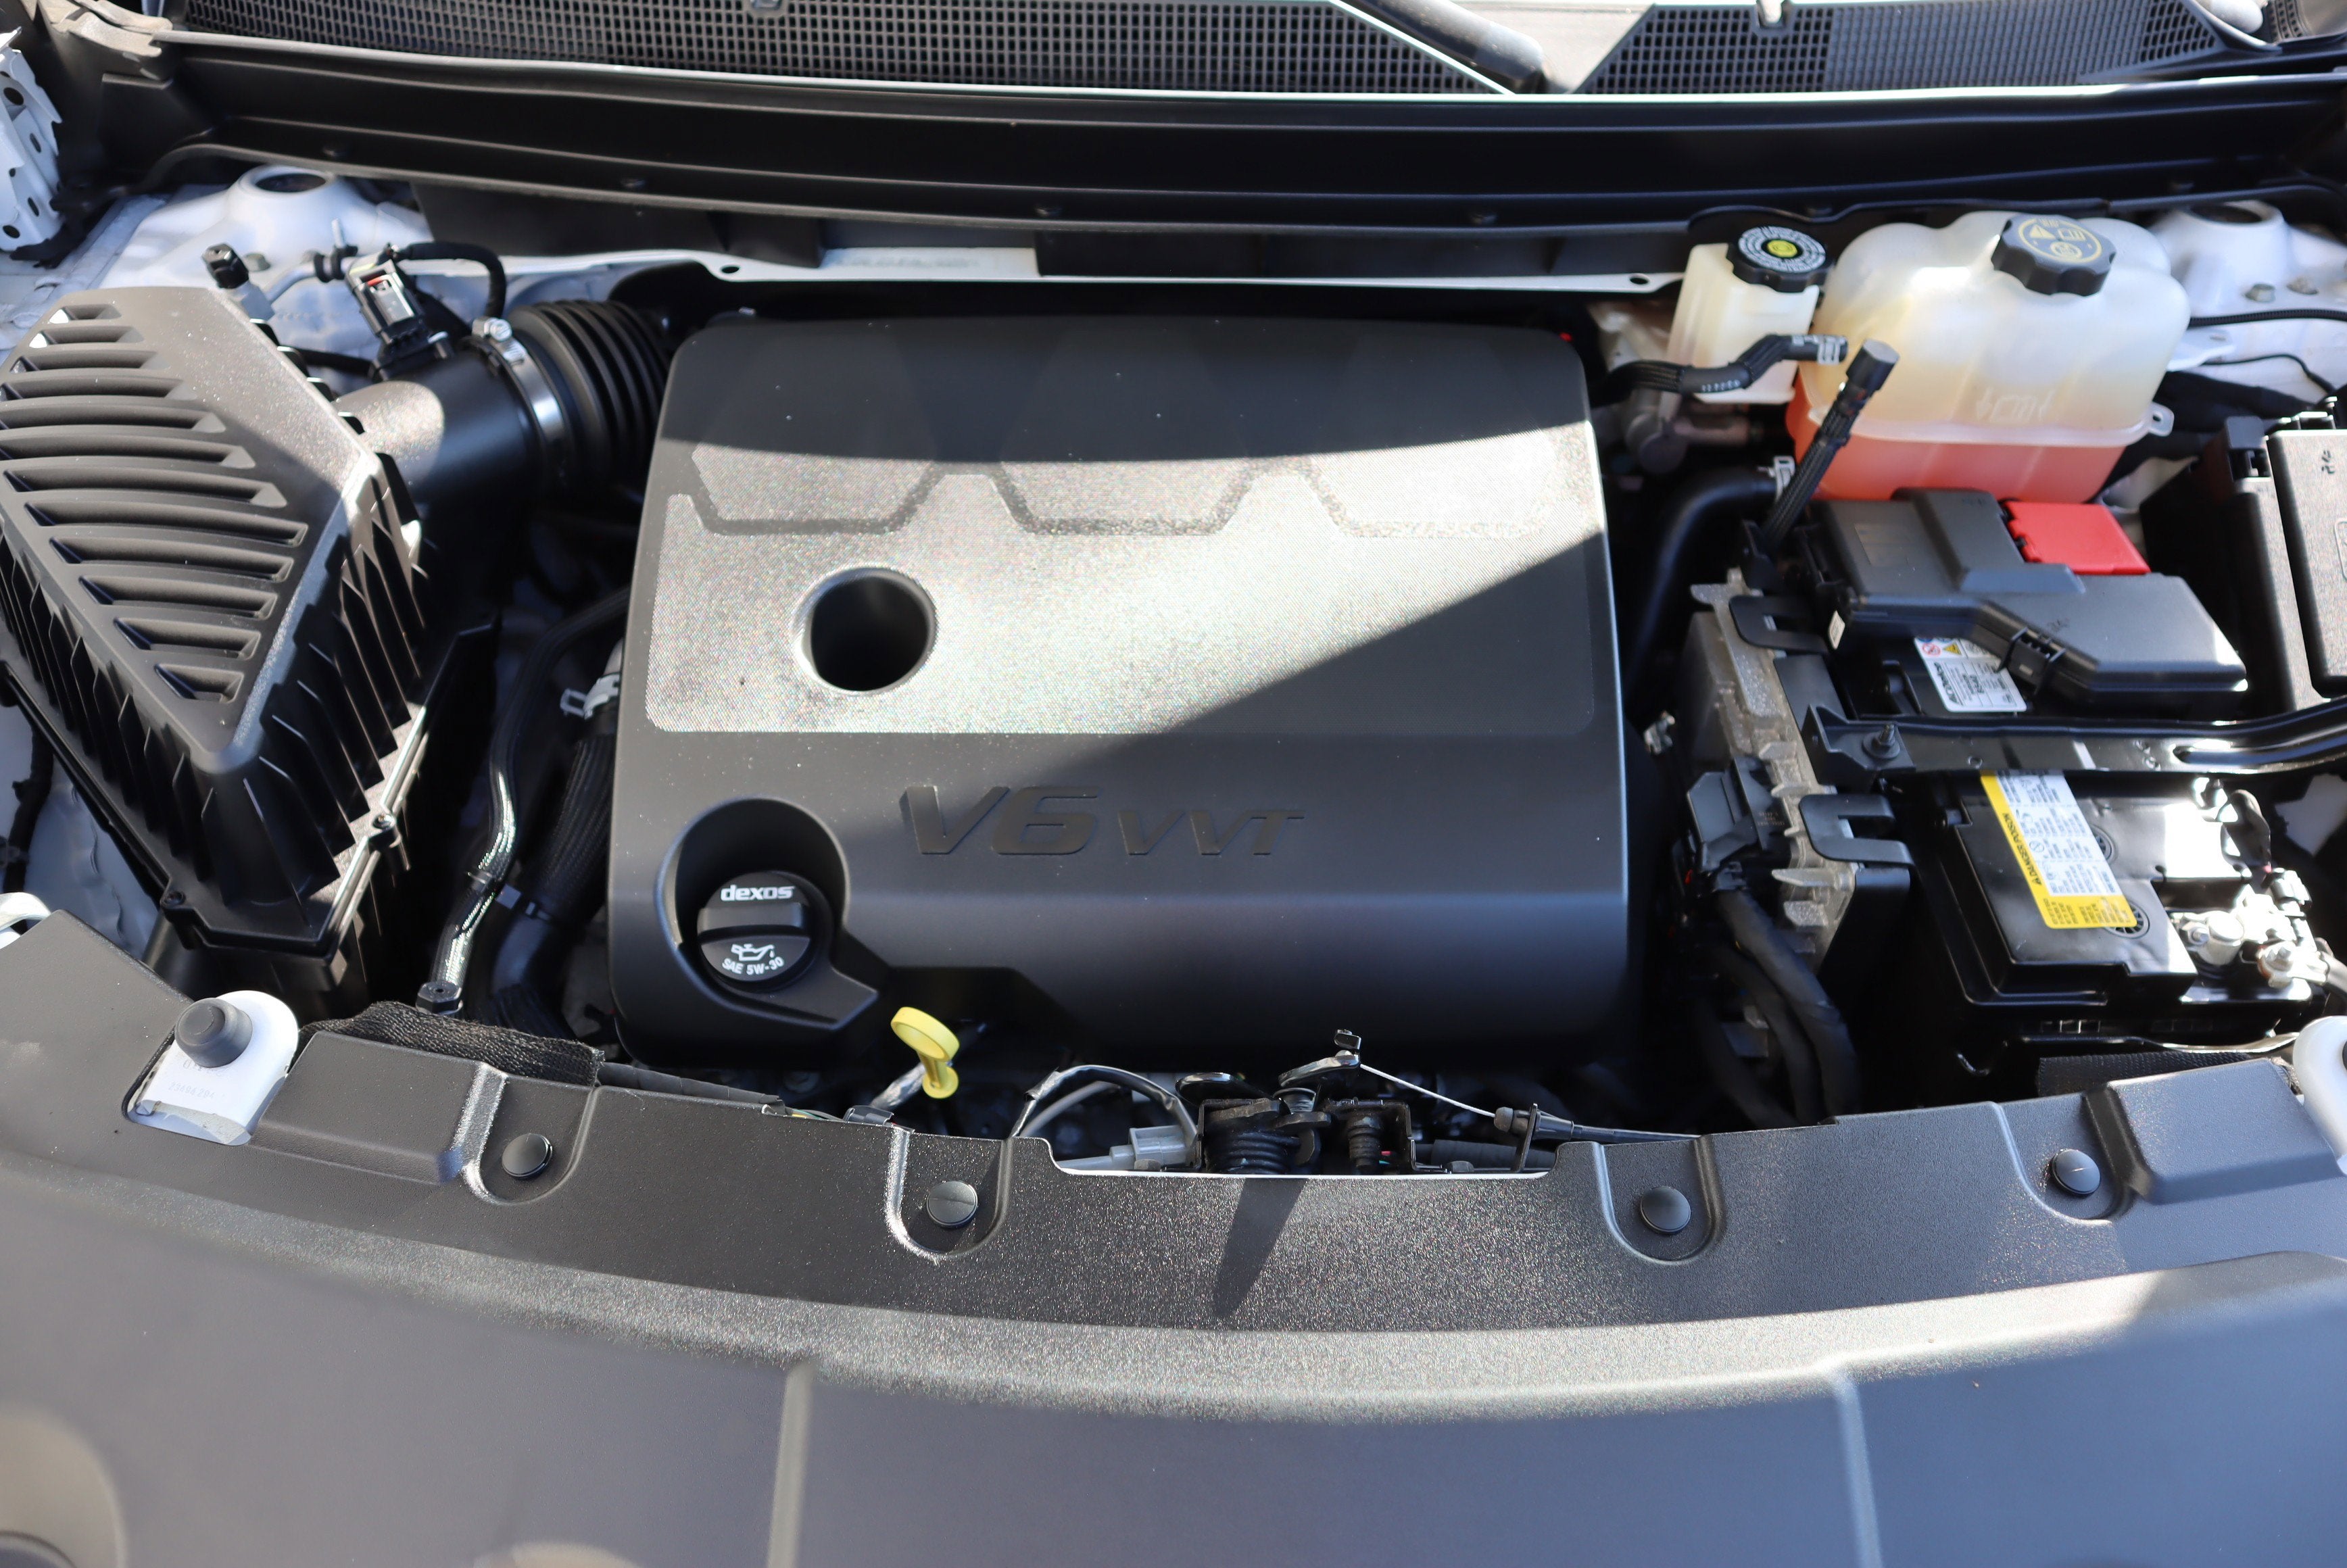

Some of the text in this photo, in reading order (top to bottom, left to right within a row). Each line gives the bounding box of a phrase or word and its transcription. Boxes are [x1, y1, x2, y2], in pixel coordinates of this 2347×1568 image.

[900, 785, 1305, 856] V6 VVT
[721, 884, 795, 902] dexos
[722, 956, 784, 975] SAE 5W-30
